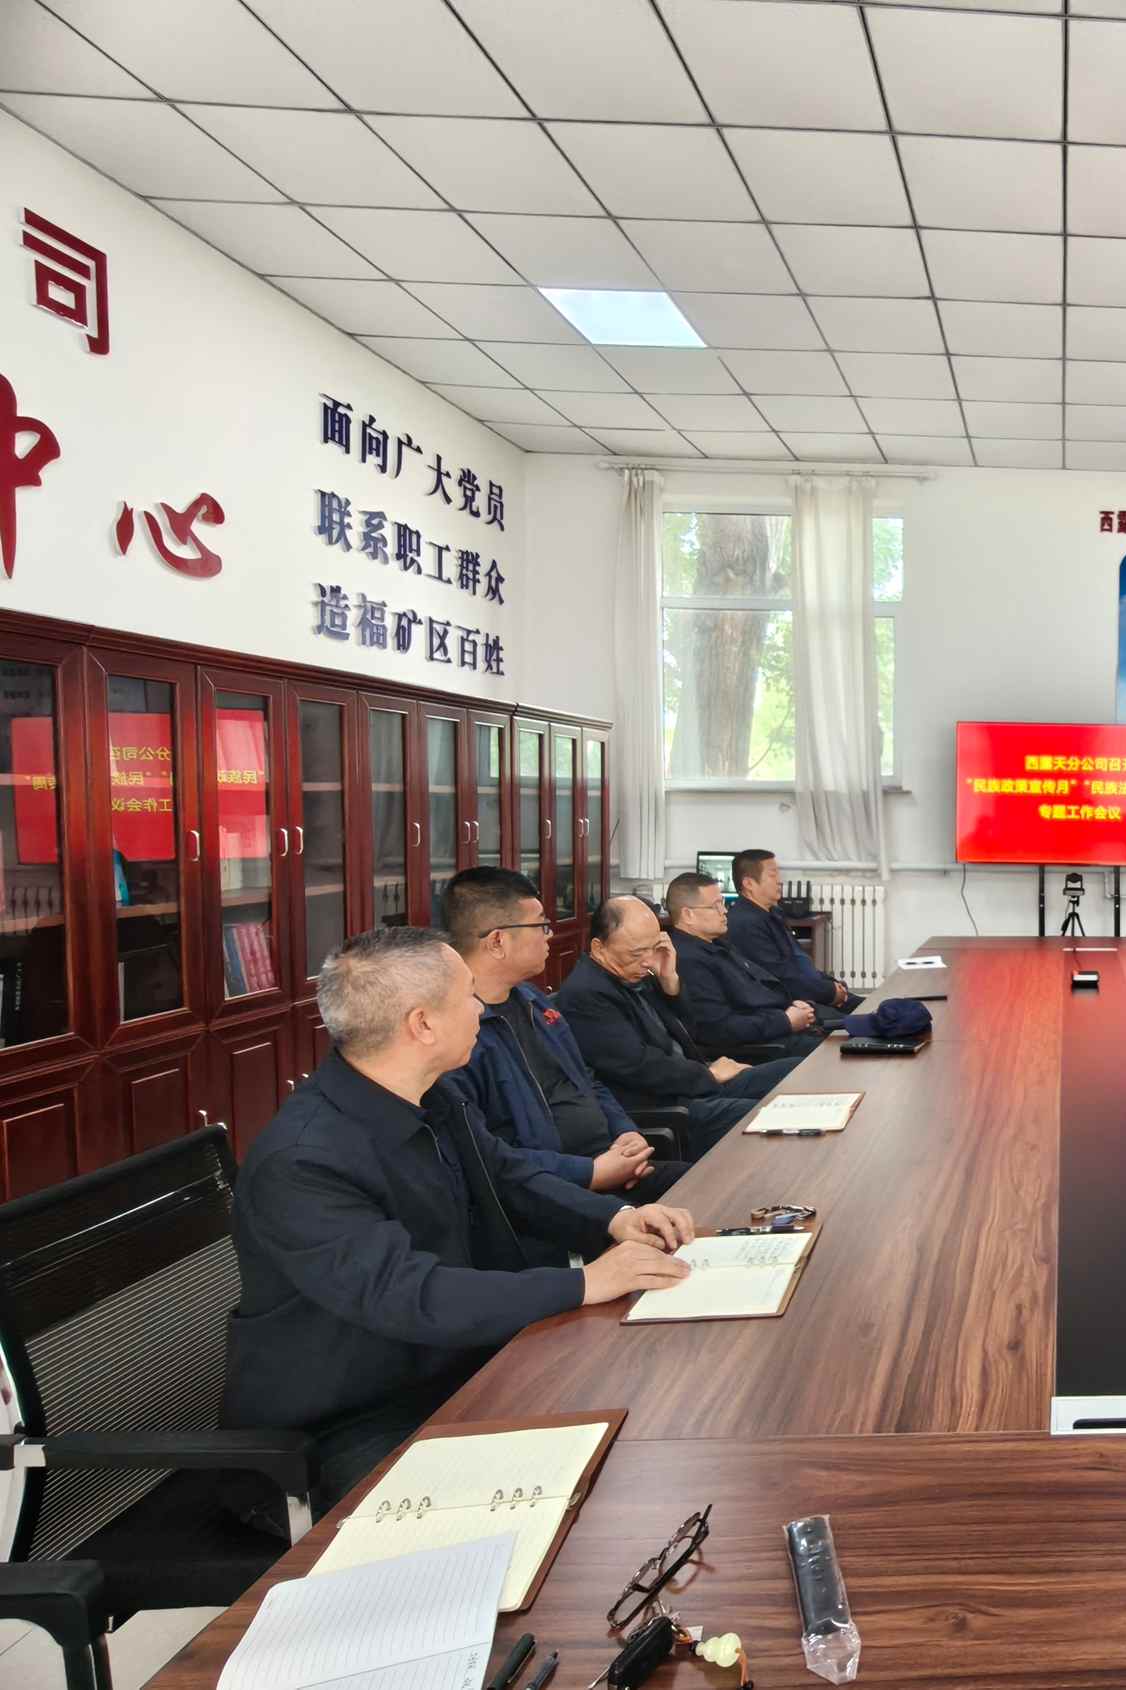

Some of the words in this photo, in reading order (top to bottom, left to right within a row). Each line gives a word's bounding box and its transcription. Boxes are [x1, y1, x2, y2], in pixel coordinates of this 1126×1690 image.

[22, 207, 110, 356] 司
[319, 391, 506, 532] 面向广大党员
[313, 488, 506, 606] 联系职工群众
[311, 582, 506, 677] 造福矿区百姓
[1038, 804, 1122, 821] 专题工作会议
